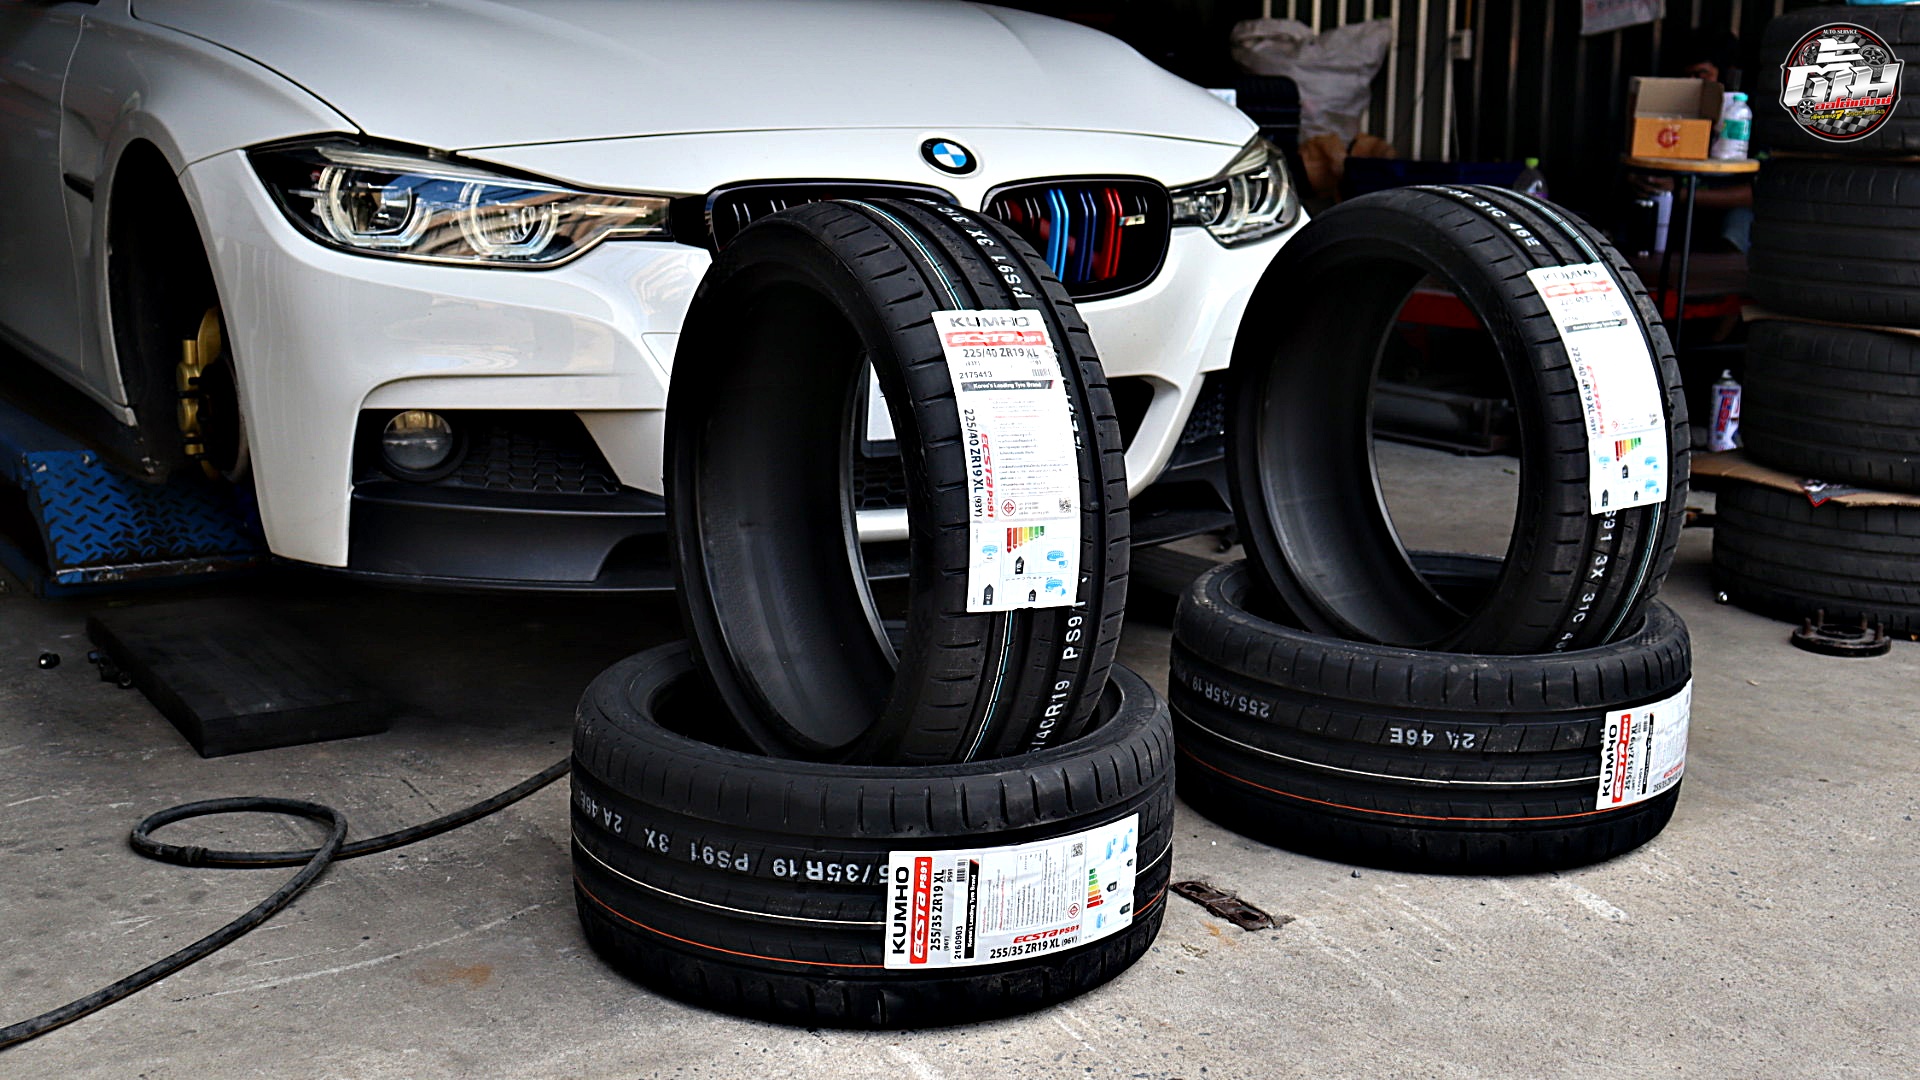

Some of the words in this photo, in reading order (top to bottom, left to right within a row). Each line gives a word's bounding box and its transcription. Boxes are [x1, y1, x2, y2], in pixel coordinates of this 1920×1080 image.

[966, 228, 995, 247] 3X
[1508, 222, 1541, 247] 46E
[991, 256, 1034, 299] PS91
[949, 316, 1031, 327] KUMHO
[963, 348, 998, 358] 225/40
[999, 347, 1025, 357] ZR19
[1026, 347, 1039, 358] XL
[959, 371, 993, 379] 2175413
[964, 408, 979, 446] 225/40
[970, 448, 983, 477] ZR19
[973, 479, 985, 493] XL
[973, 495, 983, 517] (93Y)
[1590, 554, 1609, 580] 3X
[1573, 592, 1596, 623] 31C
[1390, 727, 1435, 747] 46E
[1602, 724, 1617, 796] KUMHO
[603, 807, 623, 833] 2A
[644, 827, 670, 853] 3X
[690, 842, 749, 872] PS91
[919, 861, 928, 889] PS91
[934, 869, 945, 883] XL
[892, 866, 909, 954] KUMHO
[932, 885, 944, 913] ZR19
[930, 914, 942, 951] 255/35
[954, 925, 963, 960] 2160903
[1059, 924, 1080, 936] PS91
[990, 946, 1023, 959] 255/35
[1025, 941, 1048, 954] ZR19
[1049, 938, 1060, 948] XL
[1061, 936, 1078, 947] (96Y)
